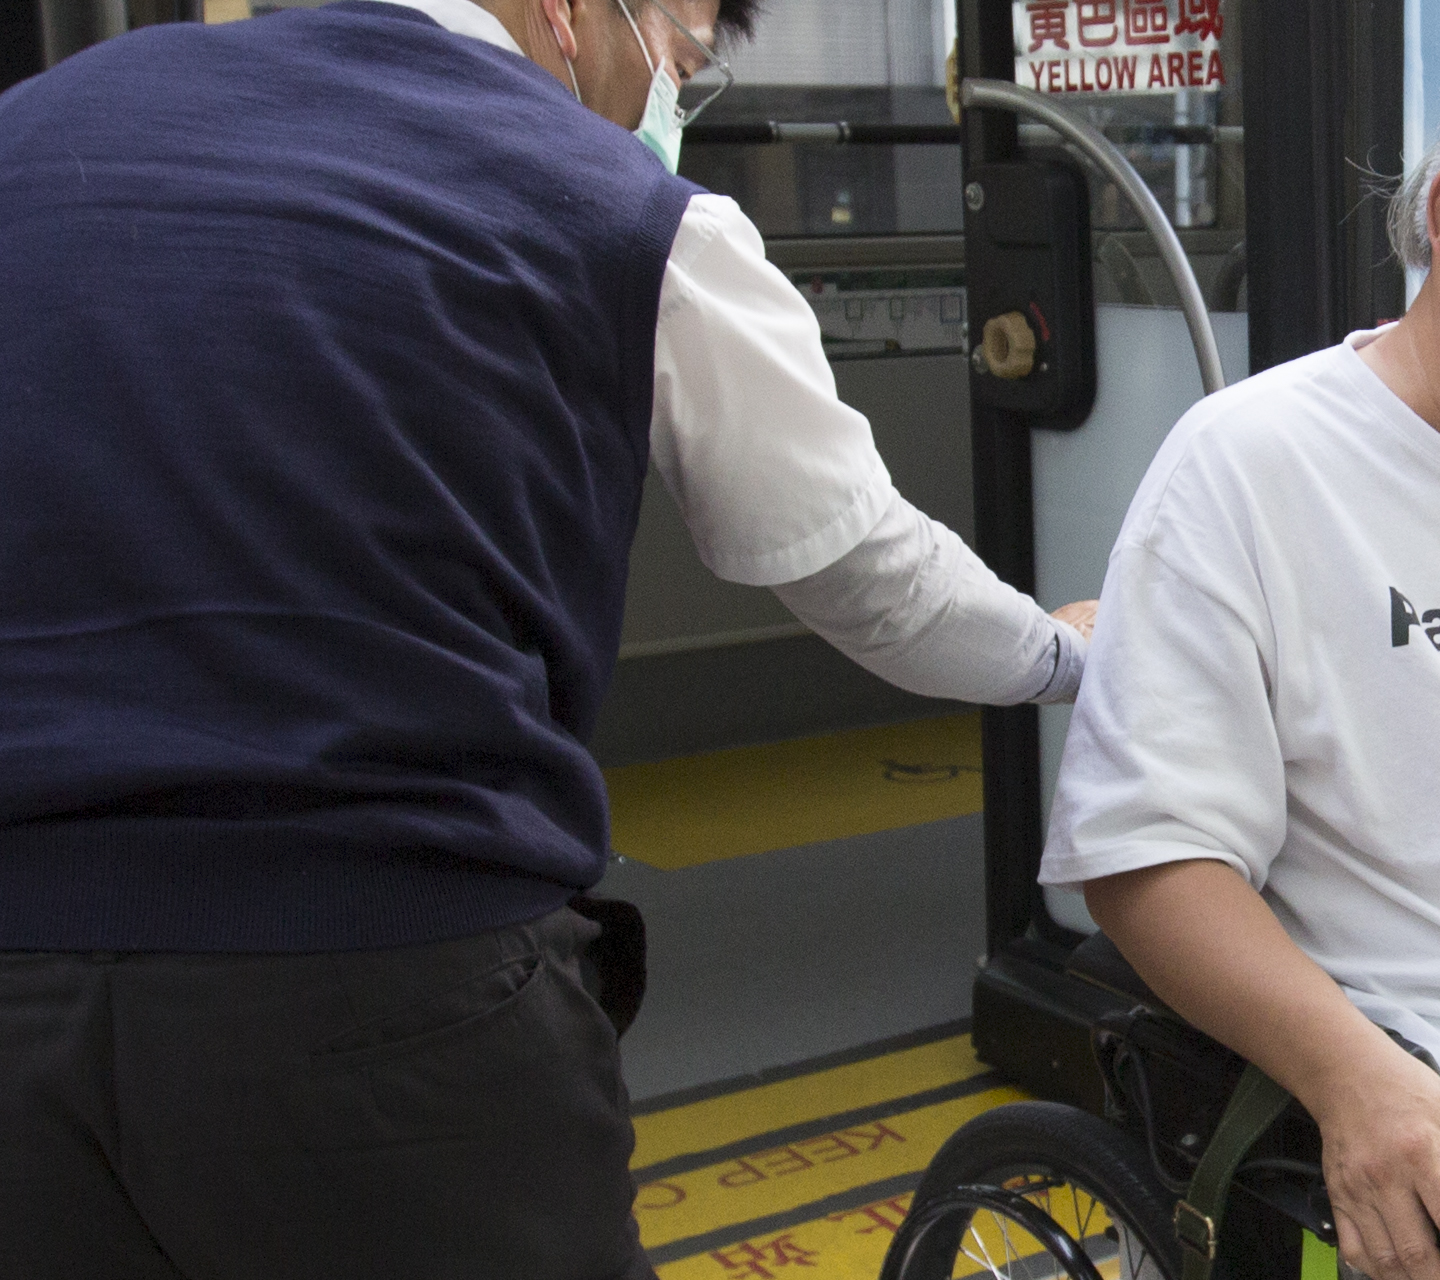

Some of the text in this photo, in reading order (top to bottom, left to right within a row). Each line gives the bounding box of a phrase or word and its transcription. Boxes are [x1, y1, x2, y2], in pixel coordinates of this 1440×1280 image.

[1029, 50, 1227, 93] YELLOW AREA
[717, 1121, 907, 1189] KEEP
